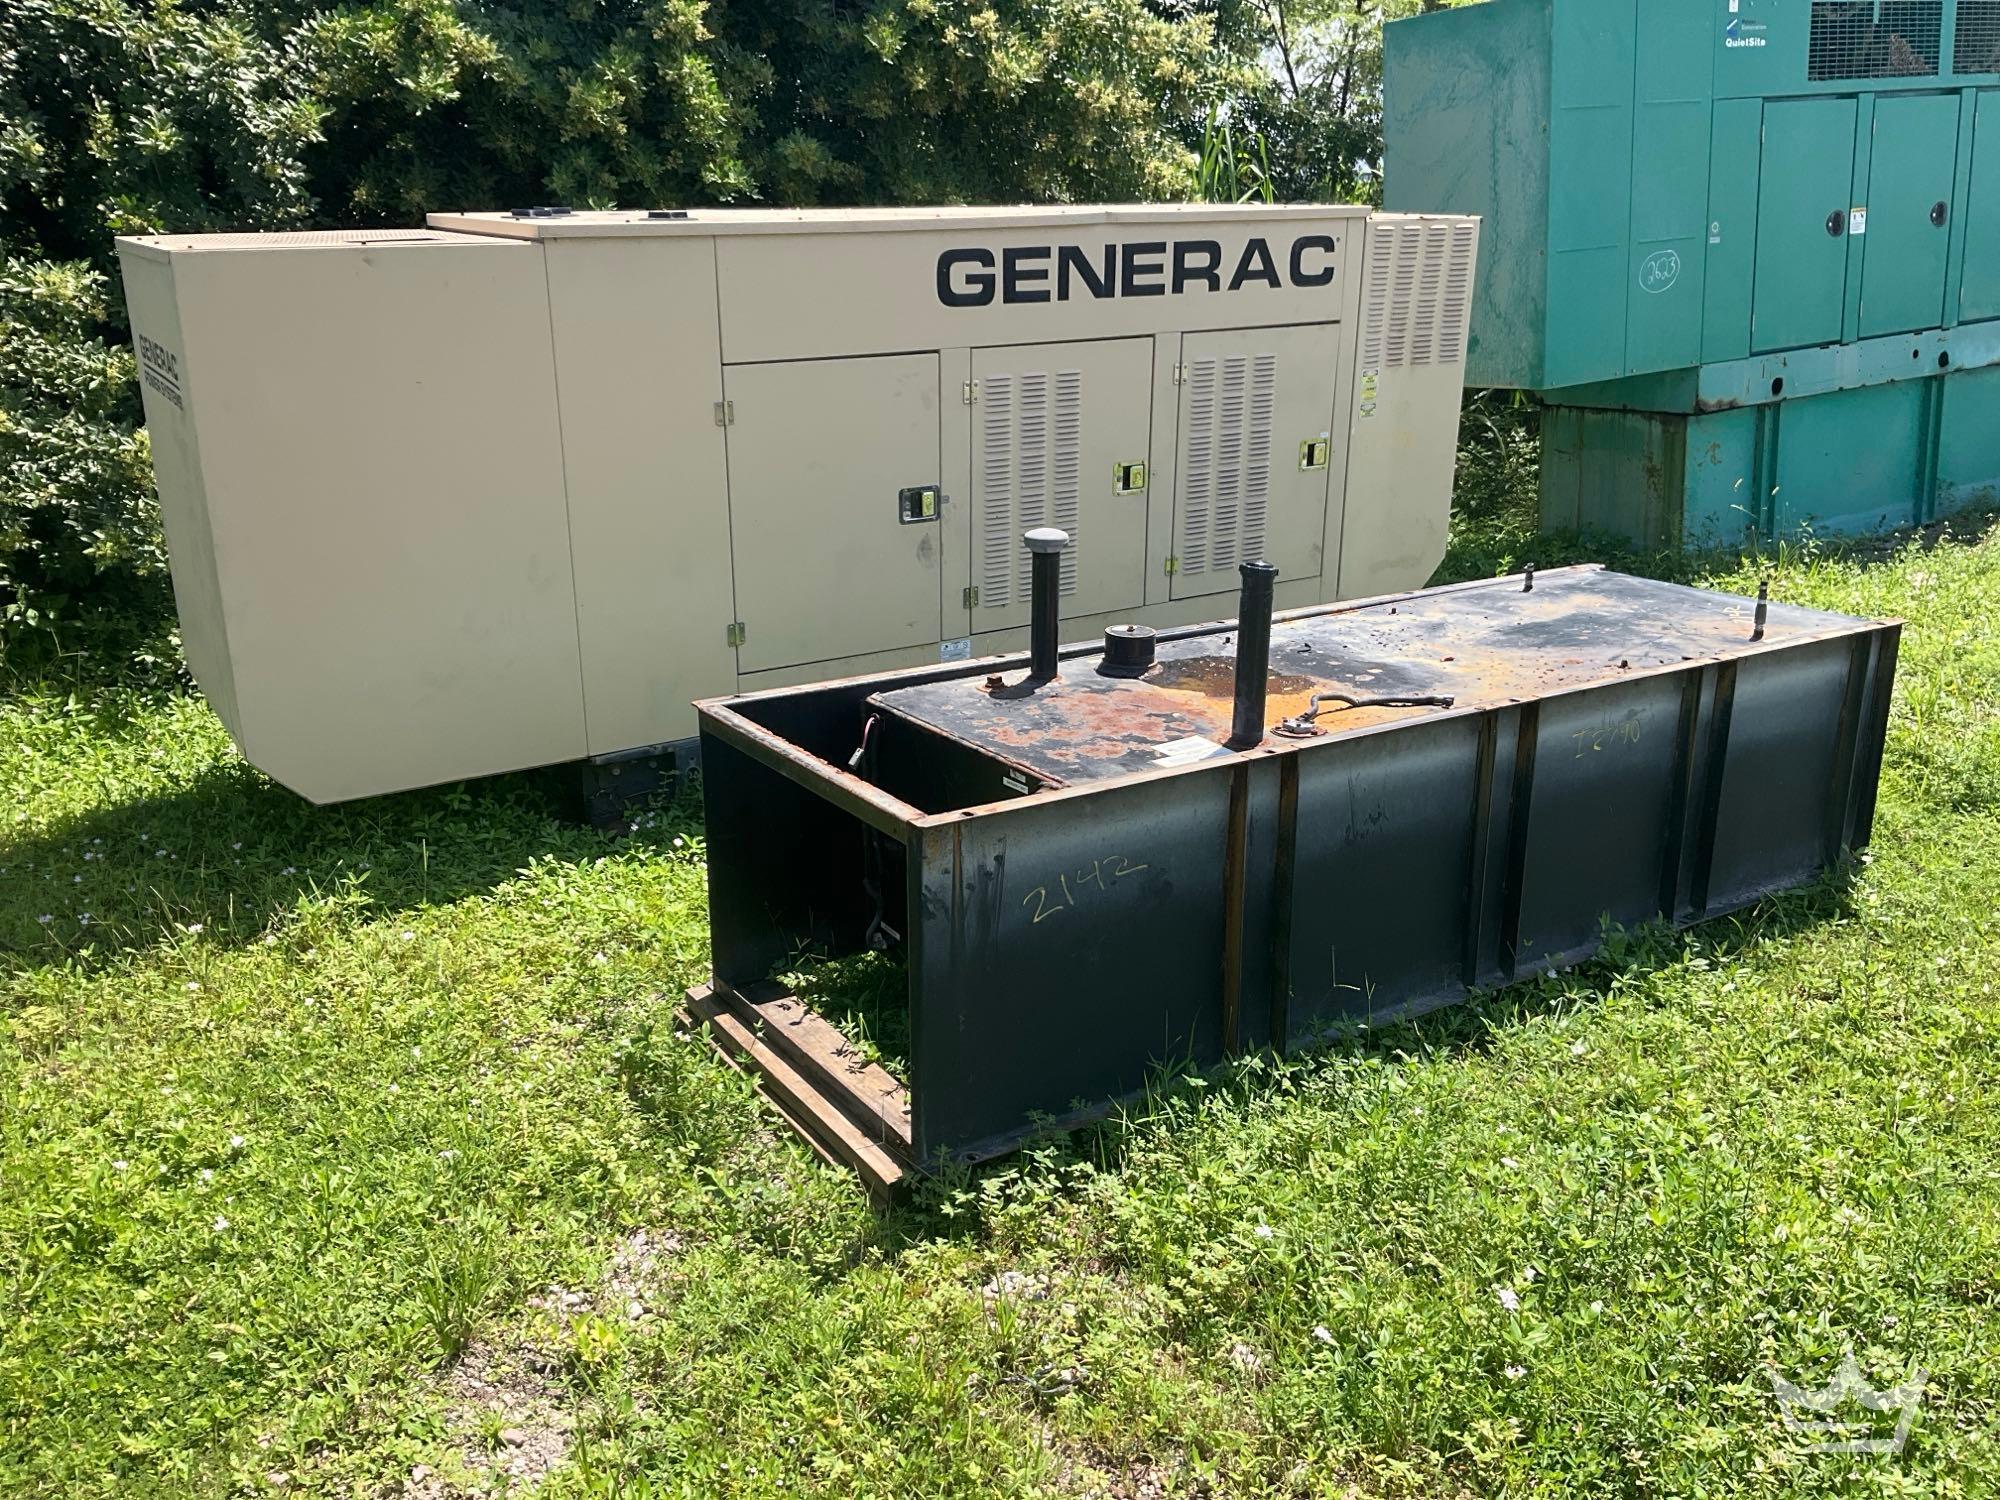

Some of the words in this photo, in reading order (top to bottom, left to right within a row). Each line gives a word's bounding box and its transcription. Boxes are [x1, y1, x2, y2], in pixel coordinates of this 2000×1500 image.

[1725, 37, 1766, 48] QuietSite
[937, 235, 1336, 308] GENERAC
[1647, 256, 1677, 285] 2623
[1023, 855, 1149, 923] 2142
